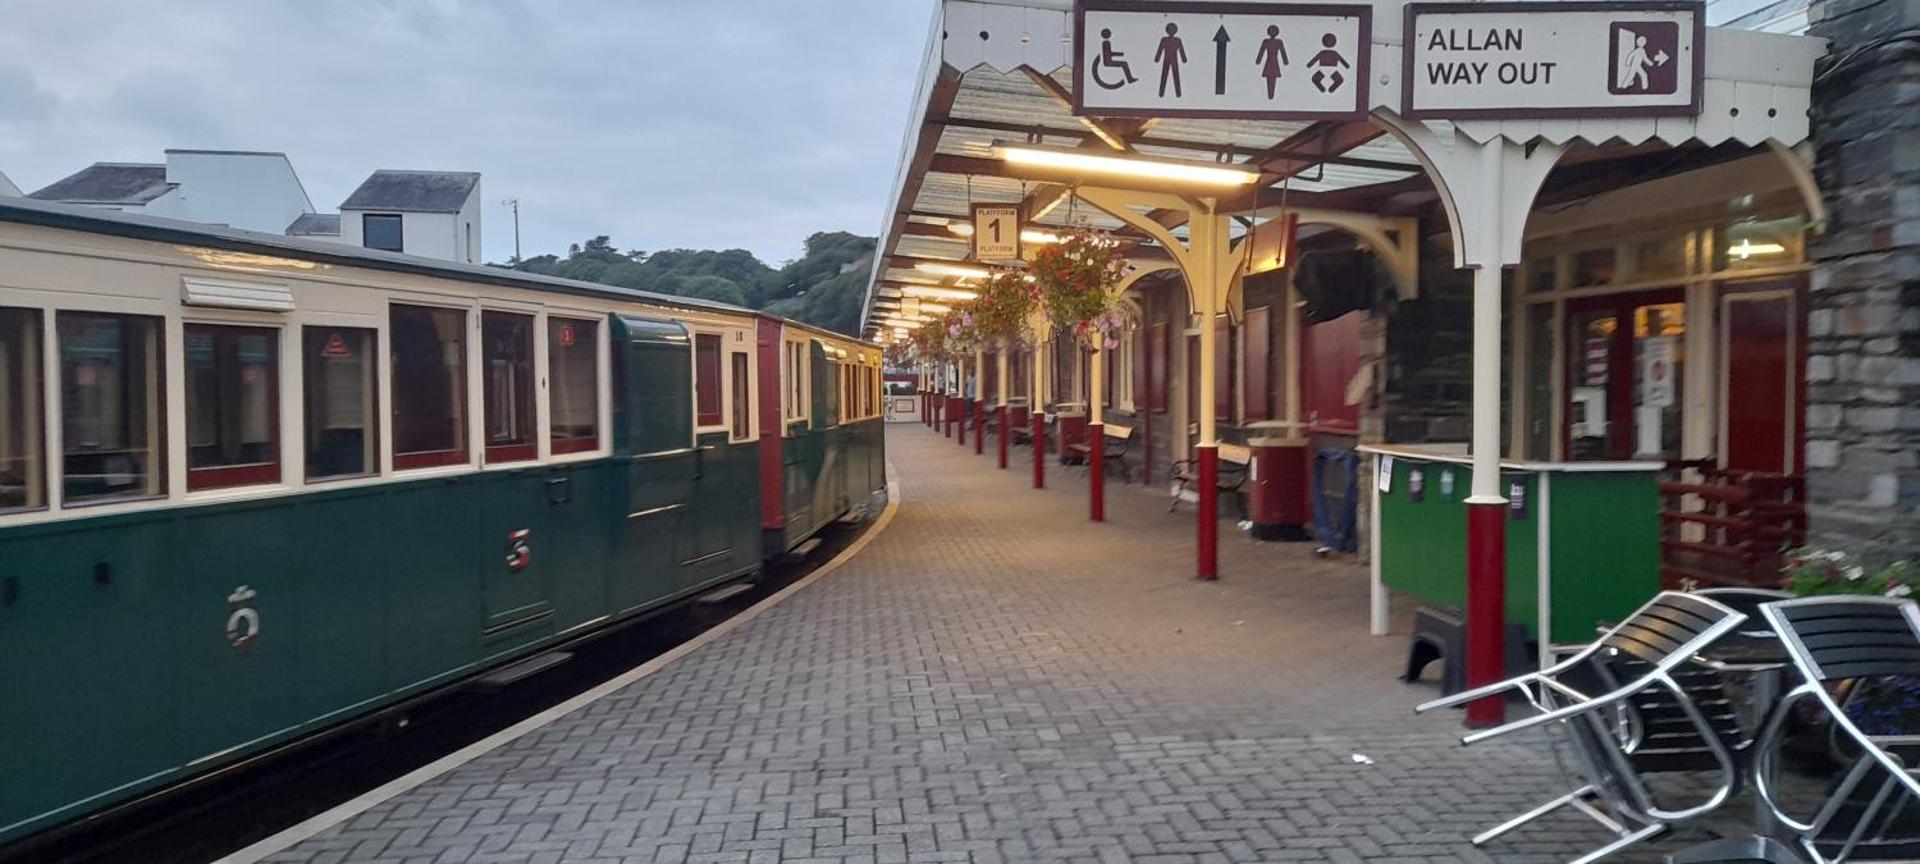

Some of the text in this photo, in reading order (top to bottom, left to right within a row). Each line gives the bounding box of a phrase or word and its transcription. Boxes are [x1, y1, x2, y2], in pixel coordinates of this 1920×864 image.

[1427, 28, 1523, 51] ALLAN
[1427, 61, 1557, 85] WAY OUT
[988, 218, 1000, 243] 1
